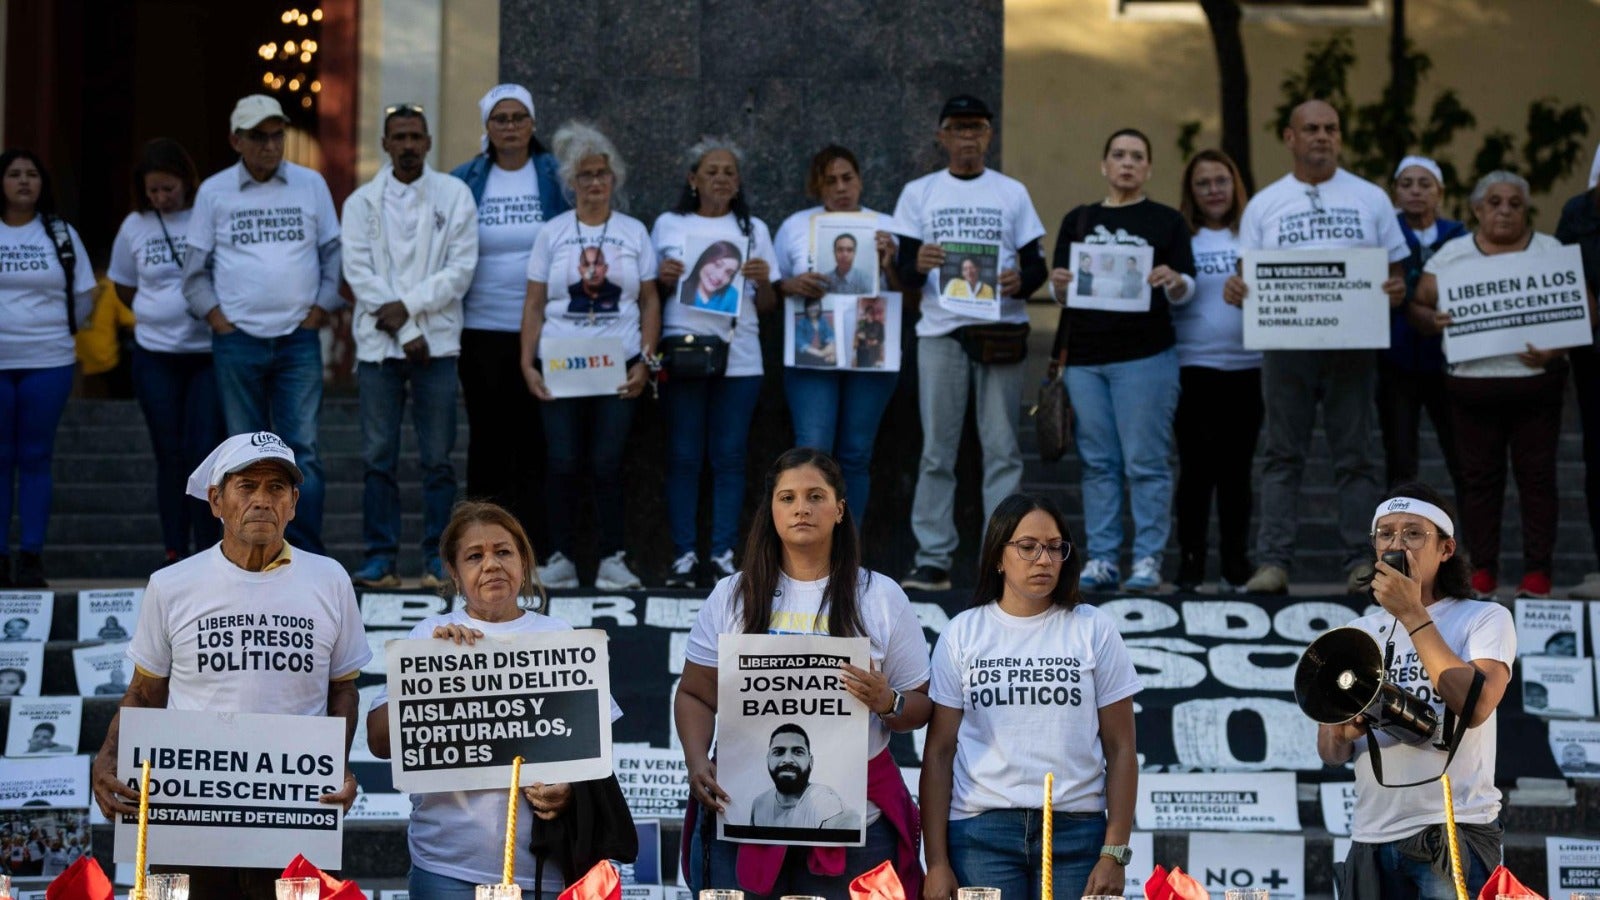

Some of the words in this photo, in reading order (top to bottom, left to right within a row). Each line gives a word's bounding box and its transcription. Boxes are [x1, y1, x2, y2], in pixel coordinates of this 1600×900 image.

[231, 220, 253, 231] LOS
[257, 216, 303, 228] PRESOS
[932, 217, 954, 228] LOS
[958, 216, 1002, 227] PRESOS
[1258, 266, 1273, 277] EN
[1258, 282, 1272, 290] LA
[1274, 279, 1372, 291] REVICTIMIZACIÓN
[1447, 278, 1522, 302] LIBEREN
[1526, 275, 1538, 290] A
[1542, 270, 1577, 288] LOS
[1258, 294, 1265, 302] Y
[1267, 294, 1281, 302] LA
[1284, 293, 1343, 302] INJUSTICIA
[1447, 290, 1582, 318] ADOLESCENTES
[1258, 306, 1272, 314] SE
[1274, 306, 1297, 314] HAN
[1258, 317, 1339, 327] NORMALIZADO
[549, 354, 615, 372] NOBEL
[198, 613, 255, 632] LIBEREN
[258, 613, 268, 627] A
[271, 614, 314, 631] TODOS
[197, 630, 234, 650] LOS
[240, 629, 314, 650] PRESOS
[197, 647, 314, 674] POLÍTICOS
[400, 653, 488, 674] PENSAR
[493, 646, 597, 669] DISTINTO
[740, 657, 806, 670] LIBERTAD
[809, 656, 846, 668] PARA
[969, 656, 1021, 671] LIBEREN
[1024, 657, 1035, 668] A
[1037, 656, 1081, 668] TODOS
[401, 677, 433, 696] NO
[439, 676, 466, 694] ES
[471, 673, 502, 692] UN
[508, 669, 594, 690] DELITO.
[969, 669, 1002, 689] LOS
[1007, 667, 1081, 684] PRESOS
[970, 682, 1082, 711] POLÍTICOS
[402, 698, 526, 723] AISLARLOS
[528, 697, 545, 716] Y
[742, 698, 852, 717] BABUEL
[402, 717, 572, 745] TORTURARLOS,
[133, 746, 249, 773] LIBEREN
[255, 752, 274, 774] A
[281, 753, 335, 777] LOS
[403, 743, 426, 767] SÍ
[430, 746, 459, 765] LO
[464, 744, 493, 763] ES
[619, 758, 640, 770] EN
[618, 773, 638, 785] SE
[32, 788, 75, 798] ARMAS
[1154, 792, 1173, 804] EN
[1174, 791, 1255, 804] VENEZUELA
[244, 810, 336, 827] DETENIDOS
[1155, 805, 1171, 814] SE
[1174, 805, 1240, 815] PERSIGUE
[1196, 815, 1276, 823] FAMILIARES
[1205, 867, 1254, 887] NO
